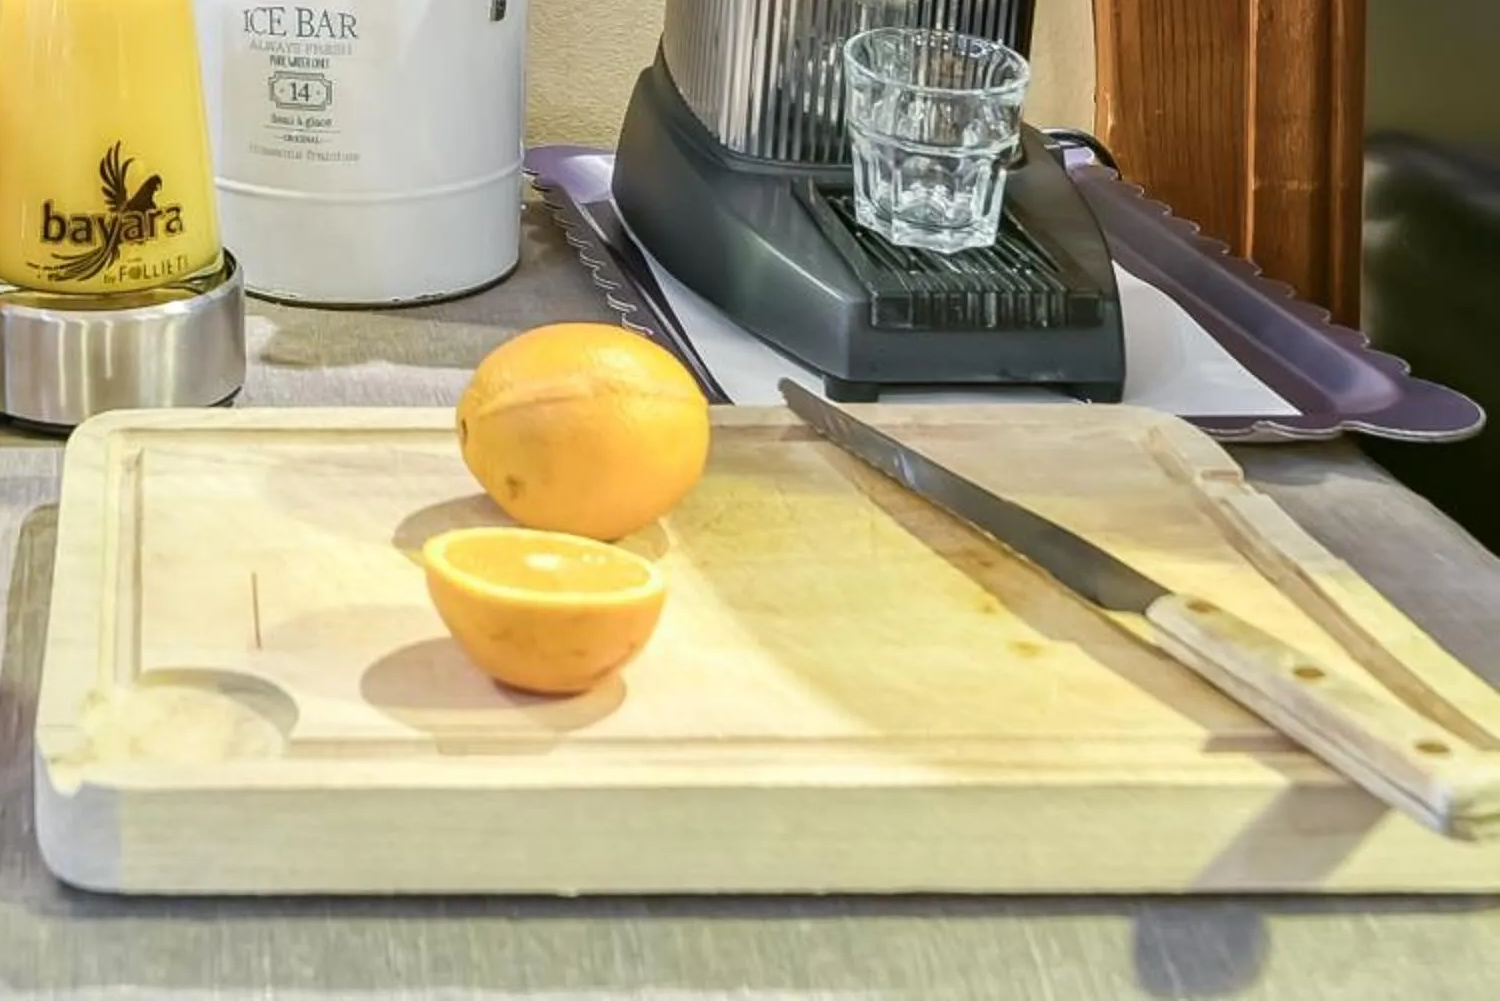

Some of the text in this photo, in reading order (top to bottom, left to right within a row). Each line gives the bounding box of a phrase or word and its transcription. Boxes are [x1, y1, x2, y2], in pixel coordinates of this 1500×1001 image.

[243, 6, 358, 38] ICE BAR
[290, 82, 310, 102] 14
[42, 199, 183, 251] bayara
